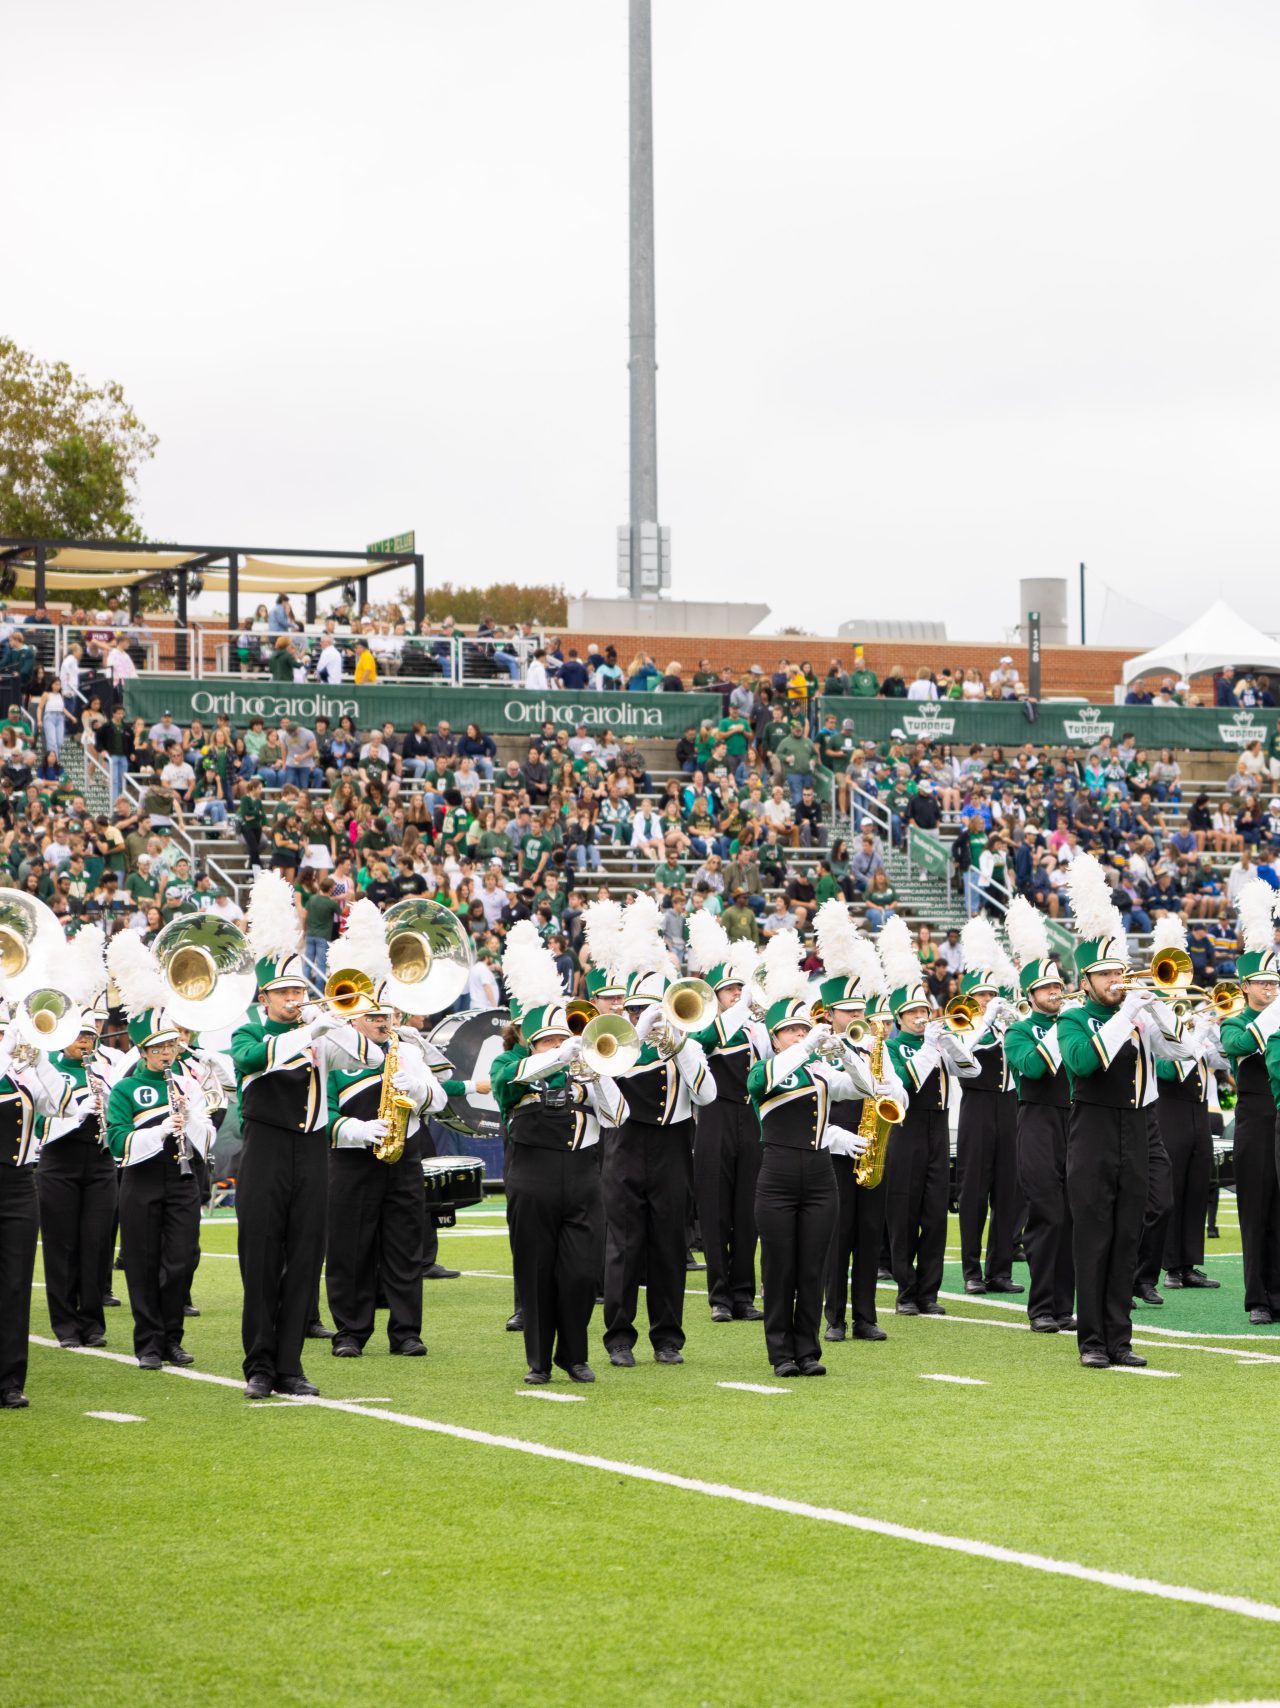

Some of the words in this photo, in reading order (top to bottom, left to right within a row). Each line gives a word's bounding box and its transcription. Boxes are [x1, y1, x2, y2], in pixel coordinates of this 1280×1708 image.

[1032, 629, 1040, 663] 128
[191, 690, 360, 718] OrthoCarolina
[504, 700, 662, 727] OrthoCarolina
